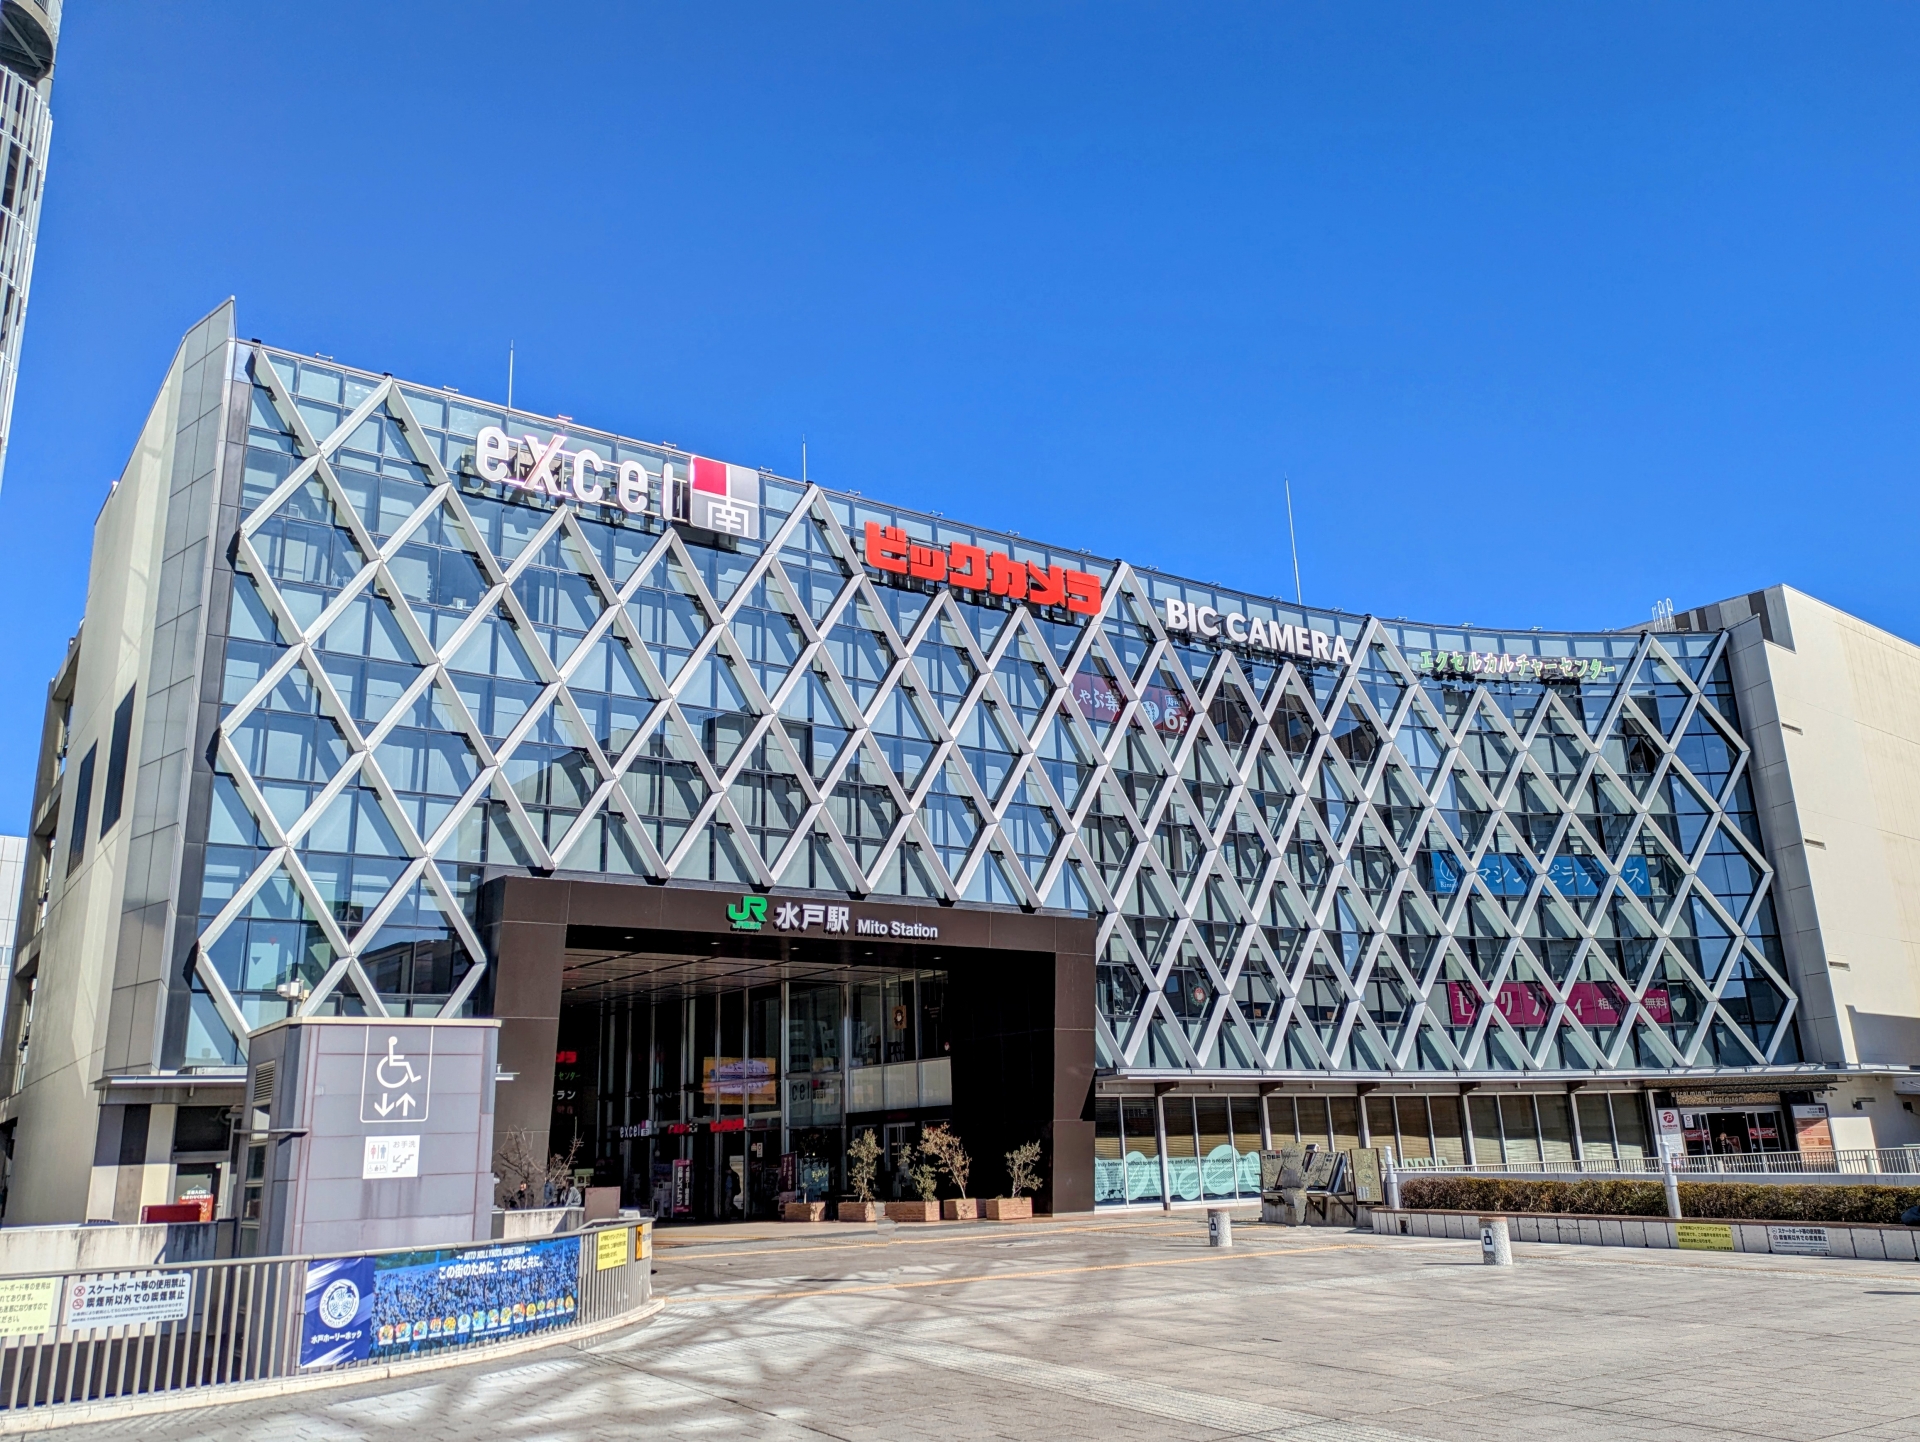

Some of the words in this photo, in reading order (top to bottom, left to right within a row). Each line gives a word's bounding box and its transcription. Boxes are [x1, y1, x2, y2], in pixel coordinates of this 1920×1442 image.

[475, 425, 674, 519] excel
[865, 521, 1102, 615] ビックカメラ
[1165, 598, 1222, 637] BIC
[1226, 612, 1352, 665] CAMERA
[1420, 650, 1616, 680] エクセルカルチャーセンター
[1164, 708, 1187, 732] 6F
[728, 896, 768, 922] JR
[775, 902, 850, 932] 水戸駅
[857, 918, 888, 934] Mito
[890, 921, 938, 938] Station
[619, 1124, 641, 1138] excel
[393, 1140, 416, 1148] お手洗
[438, 1261, 498, 1279] この街のために。
[501, 1255, 543, 1272] この街と共に。
[88, 1278, 186, 1295] スケートボード等の使用禁止
[86, 1290, 185, 1308] 喫煙所以外での喫煙禁止
[310, 1330, 363, 1344] 水戸ホーリーホック
